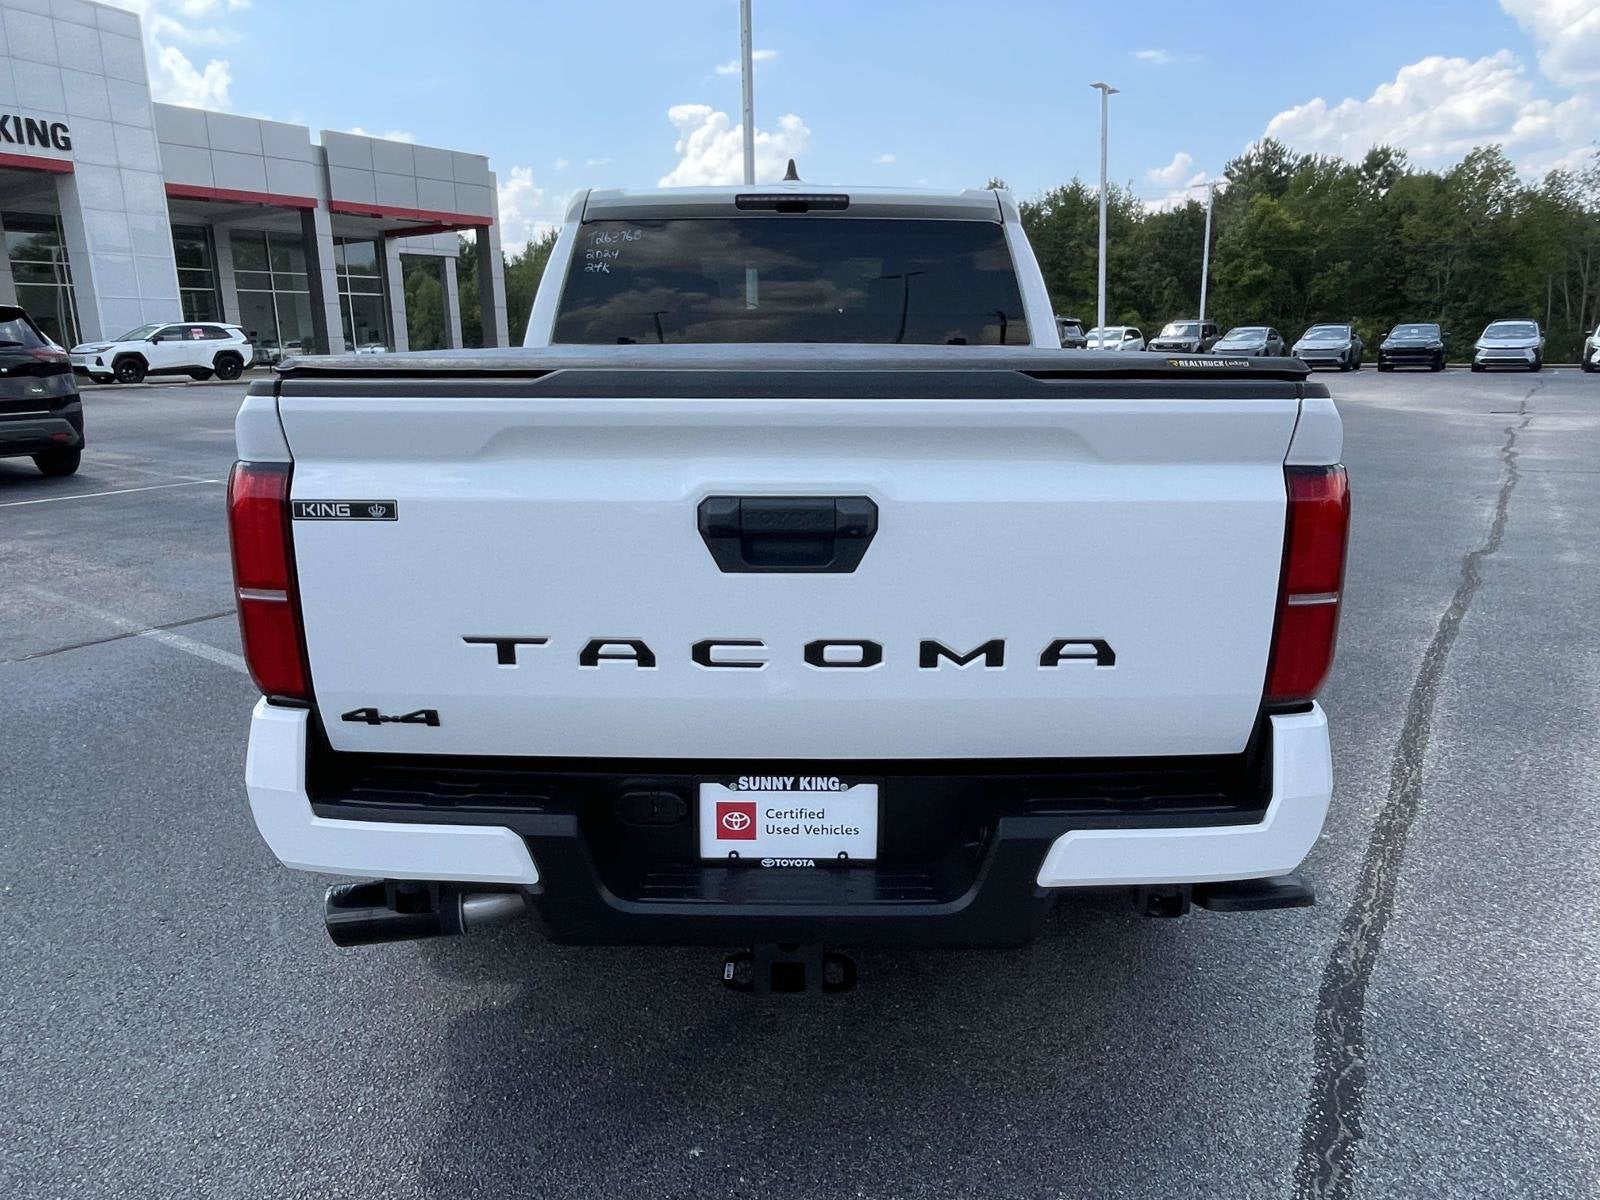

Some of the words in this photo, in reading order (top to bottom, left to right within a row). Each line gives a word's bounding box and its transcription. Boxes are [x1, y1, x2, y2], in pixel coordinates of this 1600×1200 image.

[585, 248, 619, 259] 2024
[1179, 360, 1225, 368] REALTRUCK
[302, 503, 351, 517] KING
[462, 635, 1116, 671] TACOMA
[738, 776, 794, 791] SUNNY
[800, 776, 840, 791] KING
[765, 808, 825, 820] Certified
[765, 824, 800, 836] Used
[803, 824, 860, 836] Vehicles
[774, 859, 816, 868] TOYOTA
